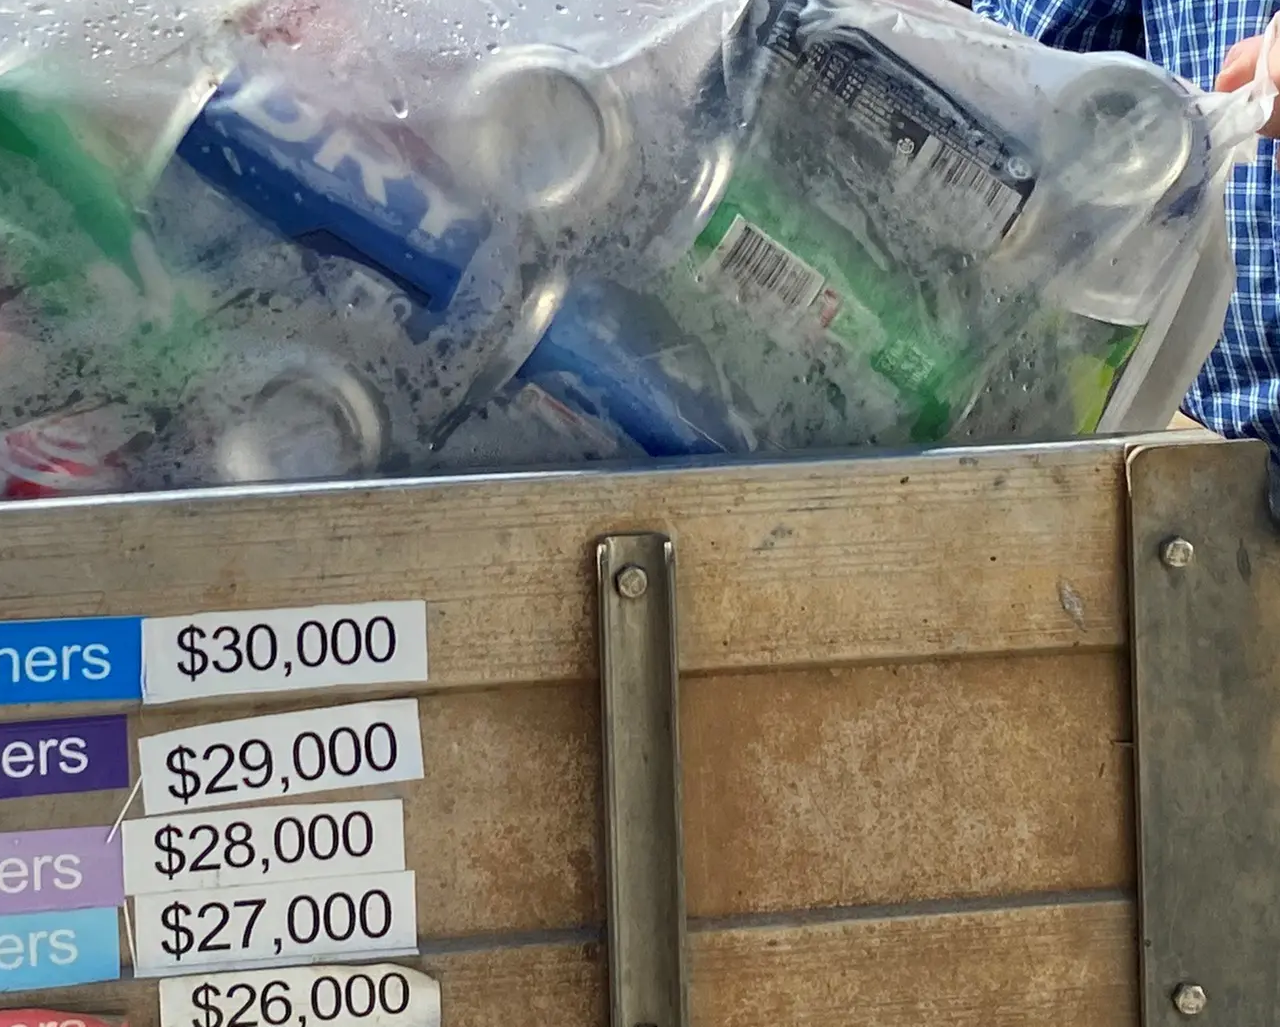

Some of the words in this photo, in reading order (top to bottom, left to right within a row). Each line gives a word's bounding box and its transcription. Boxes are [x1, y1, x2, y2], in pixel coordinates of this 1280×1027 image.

[176, 616, 397, 682] $30,000
[166, 722, 398, 805] $29,000
[154, 811, 374, 880] $28,000
[161, 889, 392, 961] $27,000
[192, 972, 410, 1027] $26,000
